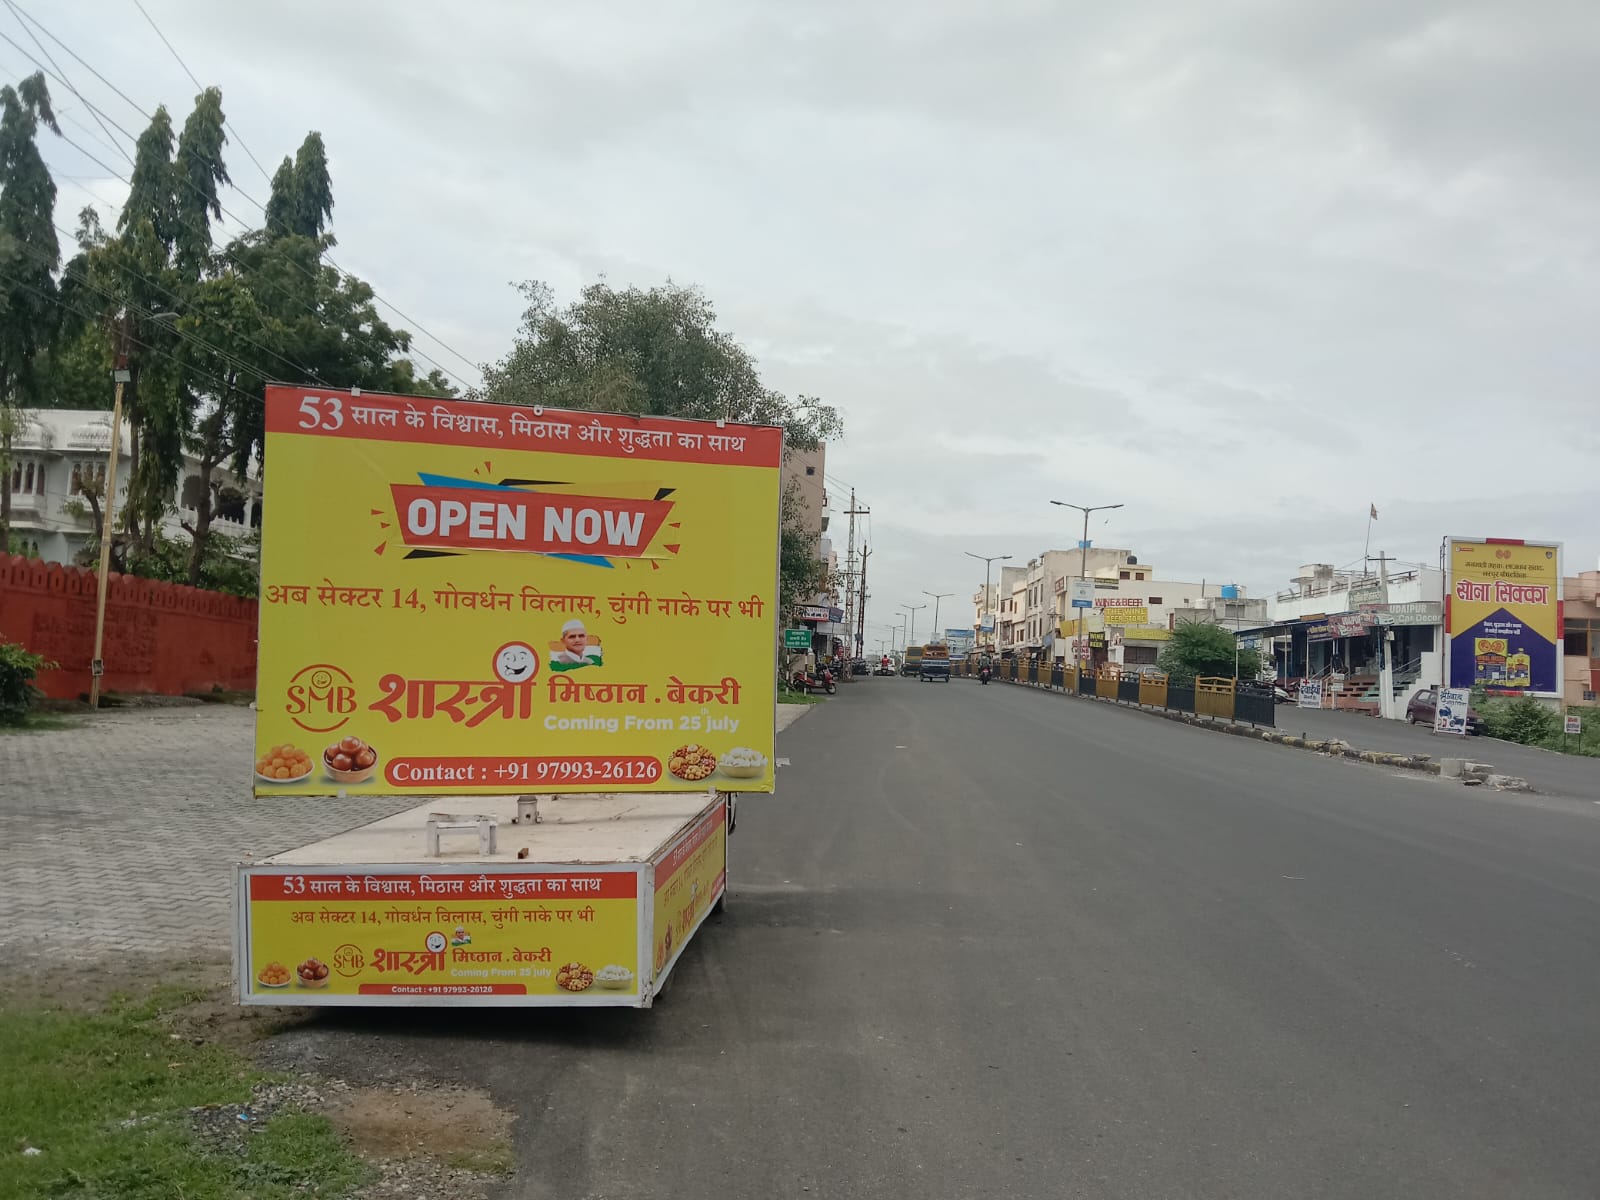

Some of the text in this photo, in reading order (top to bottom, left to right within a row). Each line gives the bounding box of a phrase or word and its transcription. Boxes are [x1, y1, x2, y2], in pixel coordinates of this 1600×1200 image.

[299, 396, 746, 454] 53 साल के विश्वास, मिठास और शुद्धता का साथ
[408, 498, 645, 547] OPEN NOW
[266, 578, 764, 625] अब सेक्टर 14, गोवर्धन विलास, चुंगी नाके पर भी
[1456, 579, 1550, 605] सोना सिक्का
[1390, 604, 1427, 613] UDAIPUR
[285, 685, 357, 714] SMB
[547, 674, 648, 703] मिष्ठान
[667, 676, 741, 705] बेकरी
[543, 715, 619, 733] Coming
[625, 716, 674, 730] From
[705, 716, 740, 733] july
[392, 762, 475, 781] Contact
[494, 762, 529, 781] +91
[537, 761, 657, 781] 97993-26126
[283, 873, 602, 899] 53 साल के विश्वास, मिठास और शुद्धता का साथ
[291, 905, 595, 929] अब सेक्टर 14, गोवर्धन विलास, चुंगी नाके पर भी
[452, 948, 503, 963] मिष्ठान
[512, 947, 552, 962] बेकरी
[451, 968, 488, 978] Coming
[491, 968, 516, 977] From
[391, 985, 422, 993] Contact
[443, 985, 492, 993] 97993-26126
